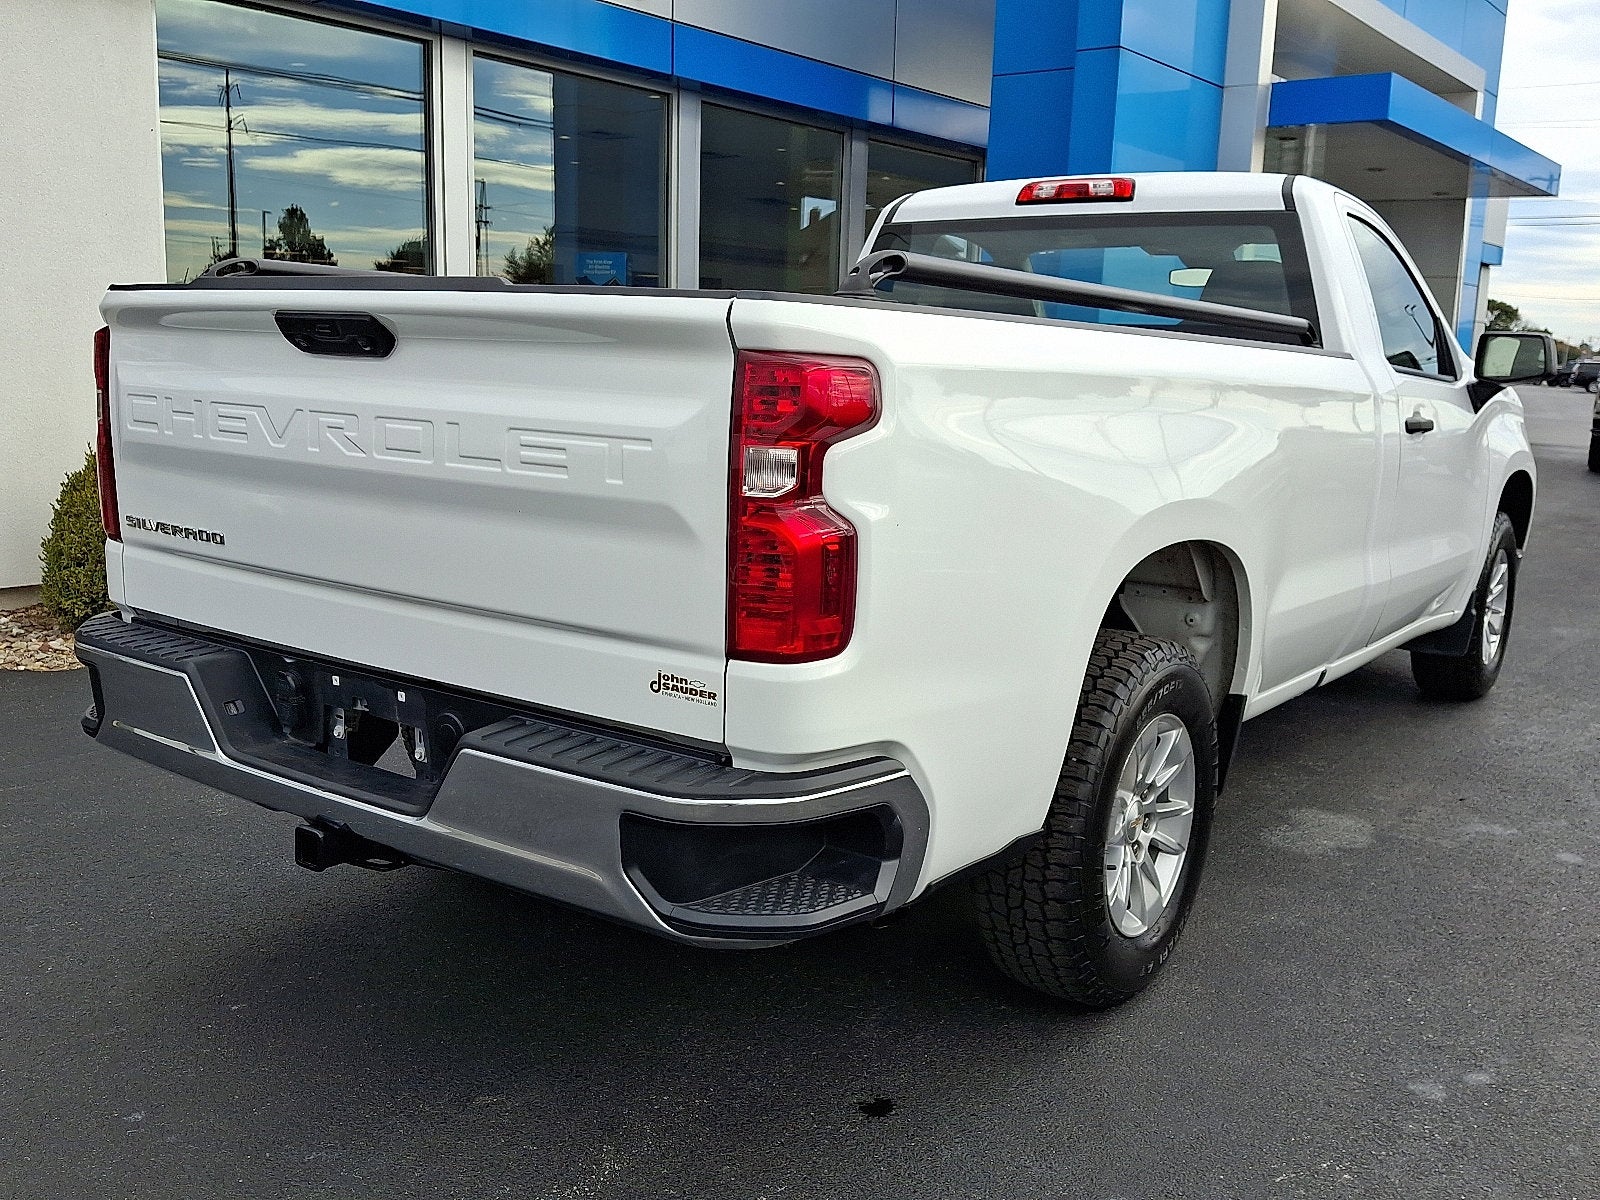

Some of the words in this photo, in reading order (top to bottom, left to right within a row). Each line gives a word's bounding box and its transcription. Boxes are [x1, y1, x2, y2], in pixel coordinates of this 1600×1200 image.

[126, 393, 653, 485] CHEVROLET
[124, 515, 226, 546] SILVERADO
[662, 682, 718, 701] SAUDER
